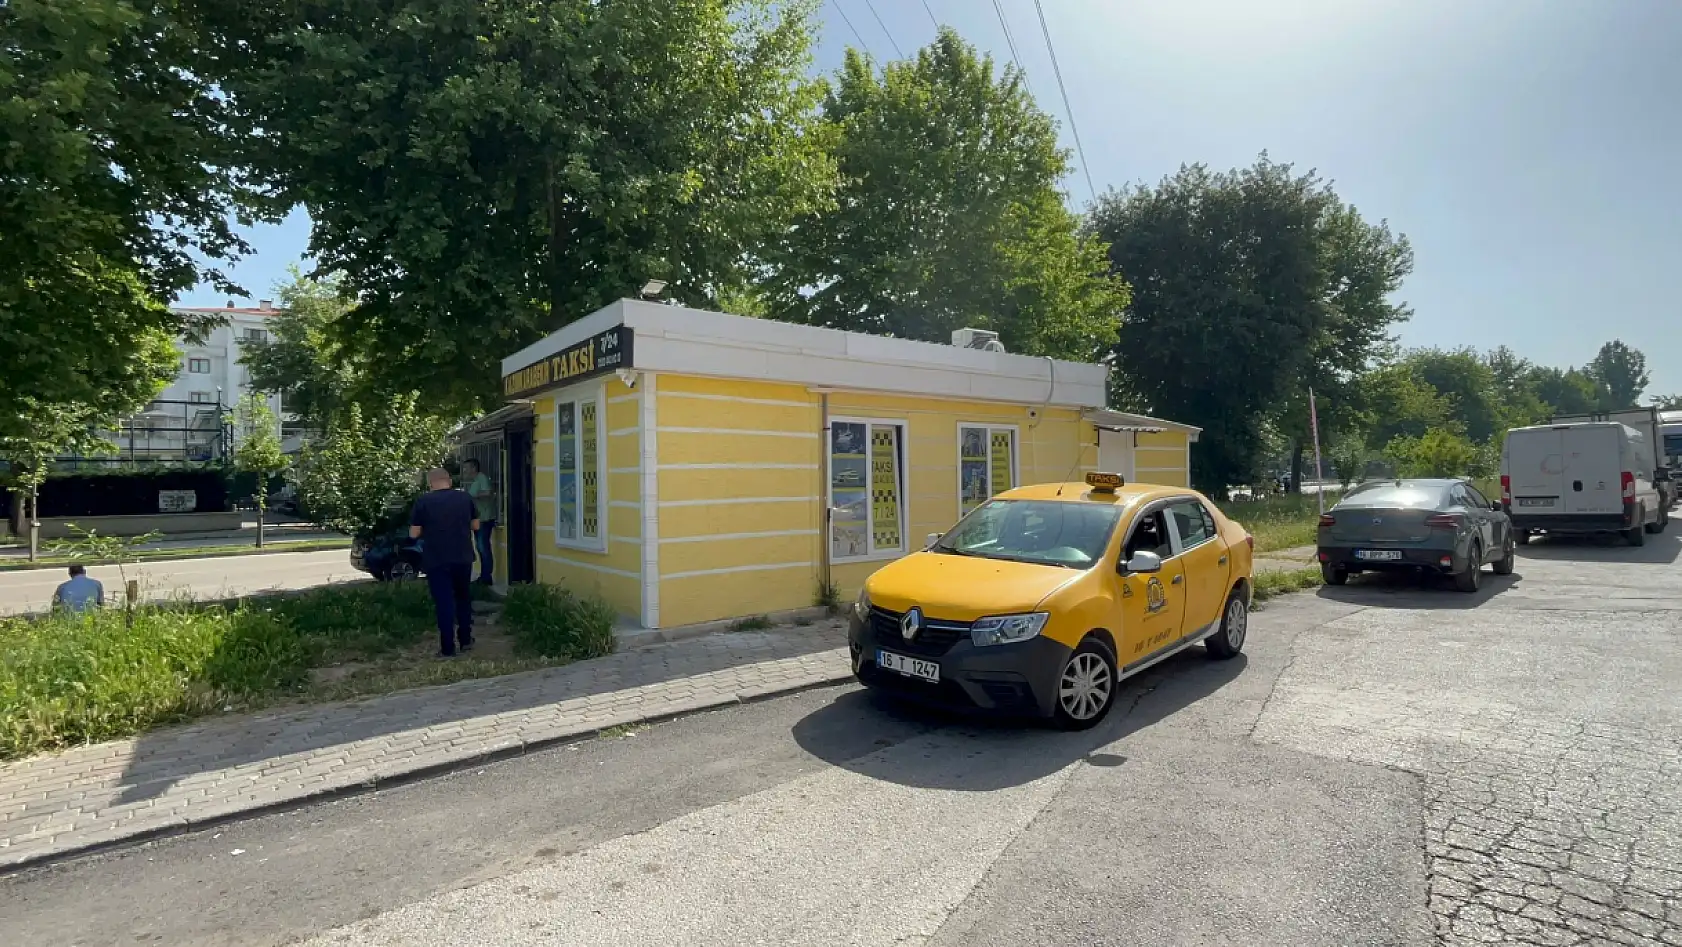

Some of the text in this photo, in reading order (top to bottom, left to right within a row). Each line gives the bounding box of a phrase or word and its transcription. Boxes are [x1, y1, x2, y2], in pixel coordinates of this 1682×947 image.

[552, 338, 595, 381] TAKSİ
[883, 652, 937, 678] 16 T 1247
